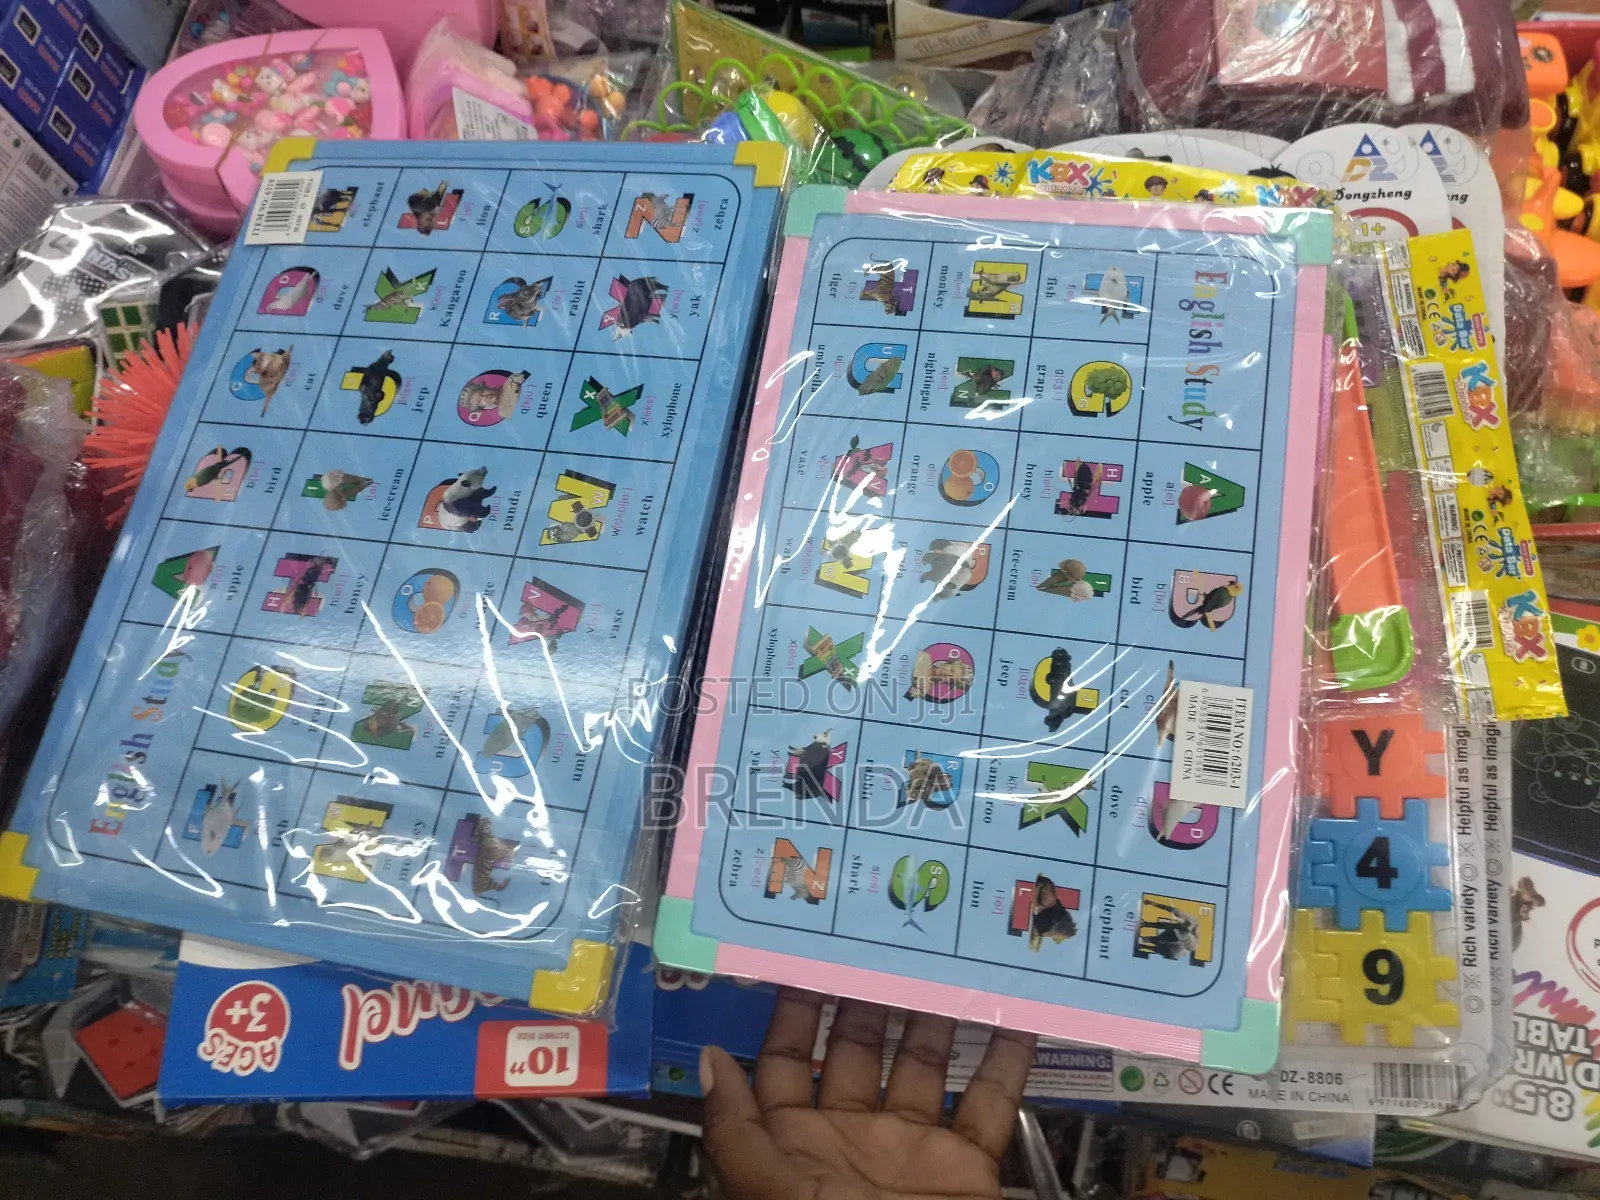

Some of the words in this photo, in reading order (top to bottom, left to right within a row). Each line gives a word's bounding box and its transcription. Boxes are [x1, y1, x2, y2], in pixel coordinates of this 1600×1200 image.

[361, 180, 386, 228] elephant
[1332, 187, 1412, 203] Dongzheng
[475, 203, 492, 228] lion
[591, 203, 609, 236] shark
[712, 197, 729, 231] zebra
[333, 284, 349, 312] dove
[438, 268, 468, 329] Kangaroo
[568, 279, 586, 318] rabbit
[828, 272, 842, 299] tiger
[932, 265, 949, 310] monkey
[1045, 277, 1058, 299] fish
[688, 294, 702, 318] yak
[1178, 270, 1229, 355] English
[411, 386, 430, 414] jeep
[919, 352, 937, 412] nightingale
[1034, 364, 1047, 400] grape
[1167, 361, 1221, 432] Study
[536, 381, 554, 420] queen
[660, 382, 682, 439] xylophone
[264, 466, 282, 494] bird
[796, 450, 808, 477] vase
[907, 454, 921, 496] orange
[376, 467, 405, 522] ice-cream
[1020, 463, 1038, 501] honey
[1141, 471, 1155, 507] apple
[502, 489, 522, 533] panda
[635, 494, 654, 537] watch
[1501, 527, 1514, 553] Data
[226, 563, 245, 602] apple
[1006, 549, 1024, 602] ice-cream
[1506, 555, 1519, 577] Bar
[344, 572, 367, 615] honey
[1129, 576, 1144, 606] bird
[609, 608, 625, 640] vase
[762, 626, 779, 679] xylophone
[996, 658, 1014, 687] jeep
[1187, 694, 1198, 723] MADE
[1234, 697, 1247, 728] ITEM
[1186, 730, 1195, 742] IN
[1232, 730, 1244, 753] NO:
[1351, 729, 1395, 776] Y
[750, 749, 762, 777] yak
[860, 757, 875, 801] rabbit
[1182, 749, 1194, 781] CHINA
[1229, 754, 1242, 789] 6203-1
[1457, 767, 1468, 783] as
[1486, 765, 1497, 781] as
[88, 731, 155, 838] English
[982, 756, 1002, 824] Kangroo
[1109, 785, 1123, 819] dove
[1456, 787, 1474, 836] Helpful
[1484, 784, 1501, 833] Helpful
[729, 848, 743, 888] zebra
[848, 854, 863, 895] shark
[1356, 837, 1398, 889] 4
[970, 879, 984, 909] lion
[1462, 884, 1480, 932] variety
[1486, 879, 1502, 925] variety
[1099, 894, 1116, 960] elephant
[1462, 936, 1478, 968] Rich
[1362, 948, 1404, 1006] 9
[223, 992, 272, 1033] 3+
[197, 1028, 282, 1076] AGES
[516, 1031, 538, 1041] size
[539, 1031, 571, 1041] screen
[1036, 1052, 1112, 1069] WARNING:
[1280, 1070, 1344, 1085] DZ-8806
[1248, 1088, 1286, 1102] MAE
[1290, 1089, 1304, 1101] IN
[1307, 1090, 1350, 1103] CHINA
